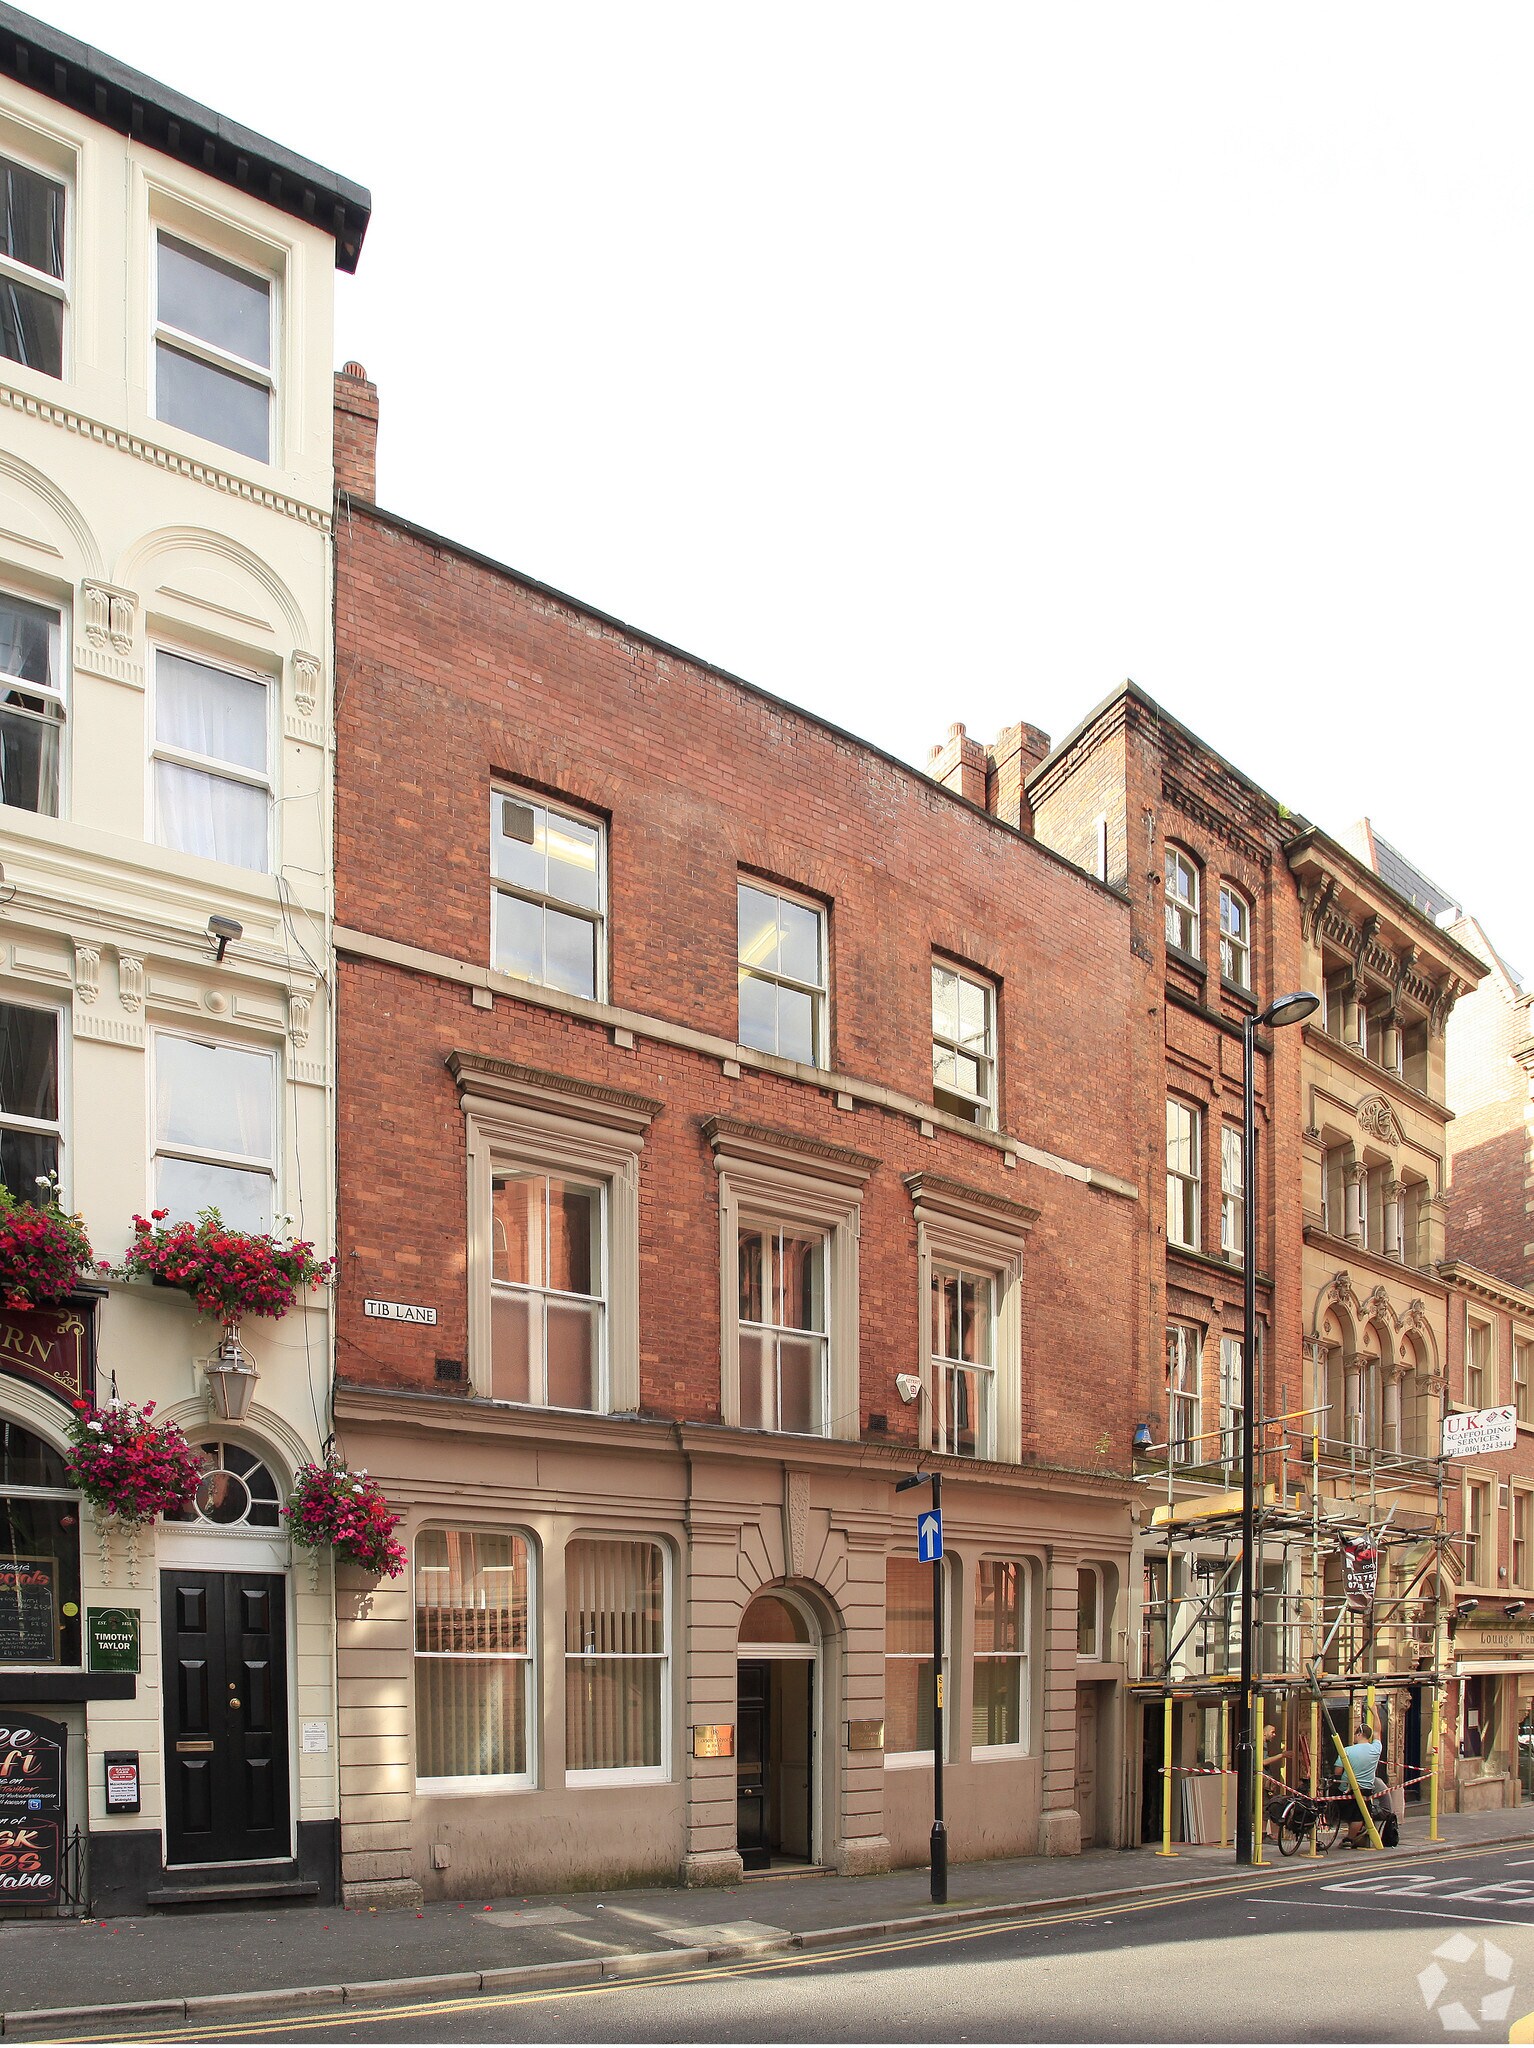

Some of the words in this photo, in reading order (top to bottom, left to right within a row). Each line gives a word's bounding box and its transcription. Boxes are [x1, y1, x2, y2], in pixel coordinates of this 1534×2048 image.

[367, 1302, 390, 1316] TIB
[396, 1305, 434, 1322] LANE
[0, 1324, 55, 1362] RN
[1447, 1415, 1484, 1433] U.K.
[1447, 1426, 1511, 1441] SCAFFOLDING
[1457, 1434, 1500, 1446] SERVICES
[1465, 1445, 1480, 1453] 0161
[1482, 1443, 1493, 1451] 224
[94, 1633, 134, 1641] TIMOTHY
[1480, 1632, 1514, 1647] Lounge
[98, 1642, 130, 1650] TAYLOR
[10, 1816, 27, 1825] of
